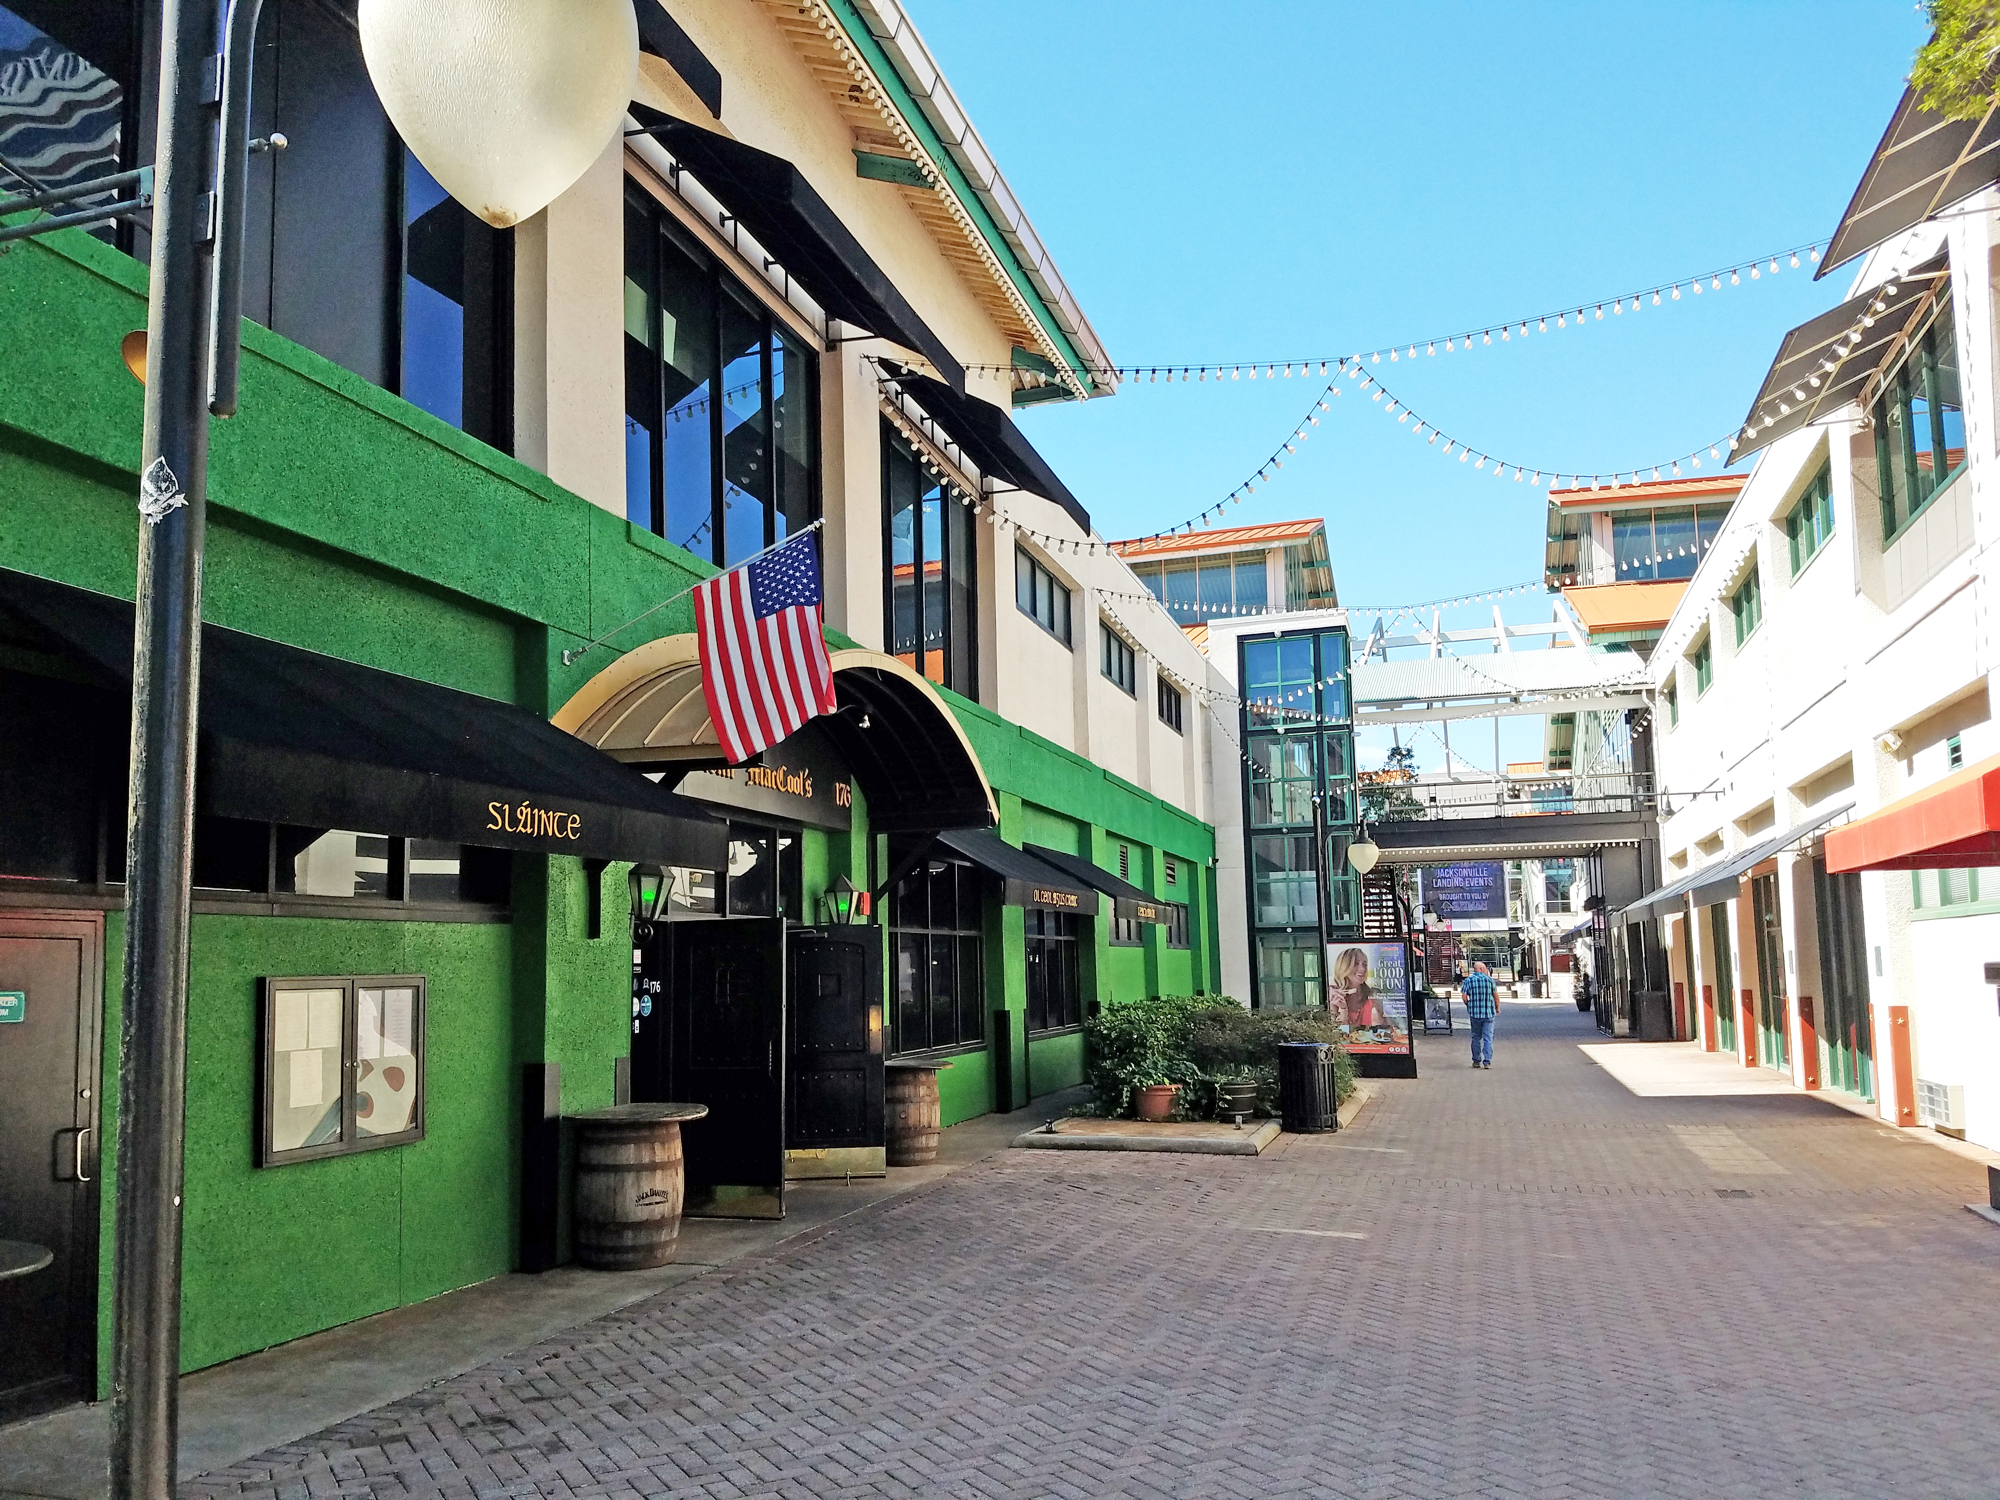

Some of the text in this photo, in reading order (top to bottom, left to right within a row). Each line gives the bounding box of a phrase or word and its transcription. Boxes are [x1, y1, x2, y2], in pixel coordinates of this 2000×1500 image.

[835, 782, 852, 808] 176
[1437, 867, 1488, 878] JACKSONVILLE
[1433, 877, 1493, 888] LANDING EVENTS
[1439, 893, 1463, 901] BROUGHT
[1378, 959, 1401, 968] Great
[1374, 967, 1404, 979] FOOD
[650, 981, 661, 994] 176
[1380, 978, 1405, 990] FUN!
